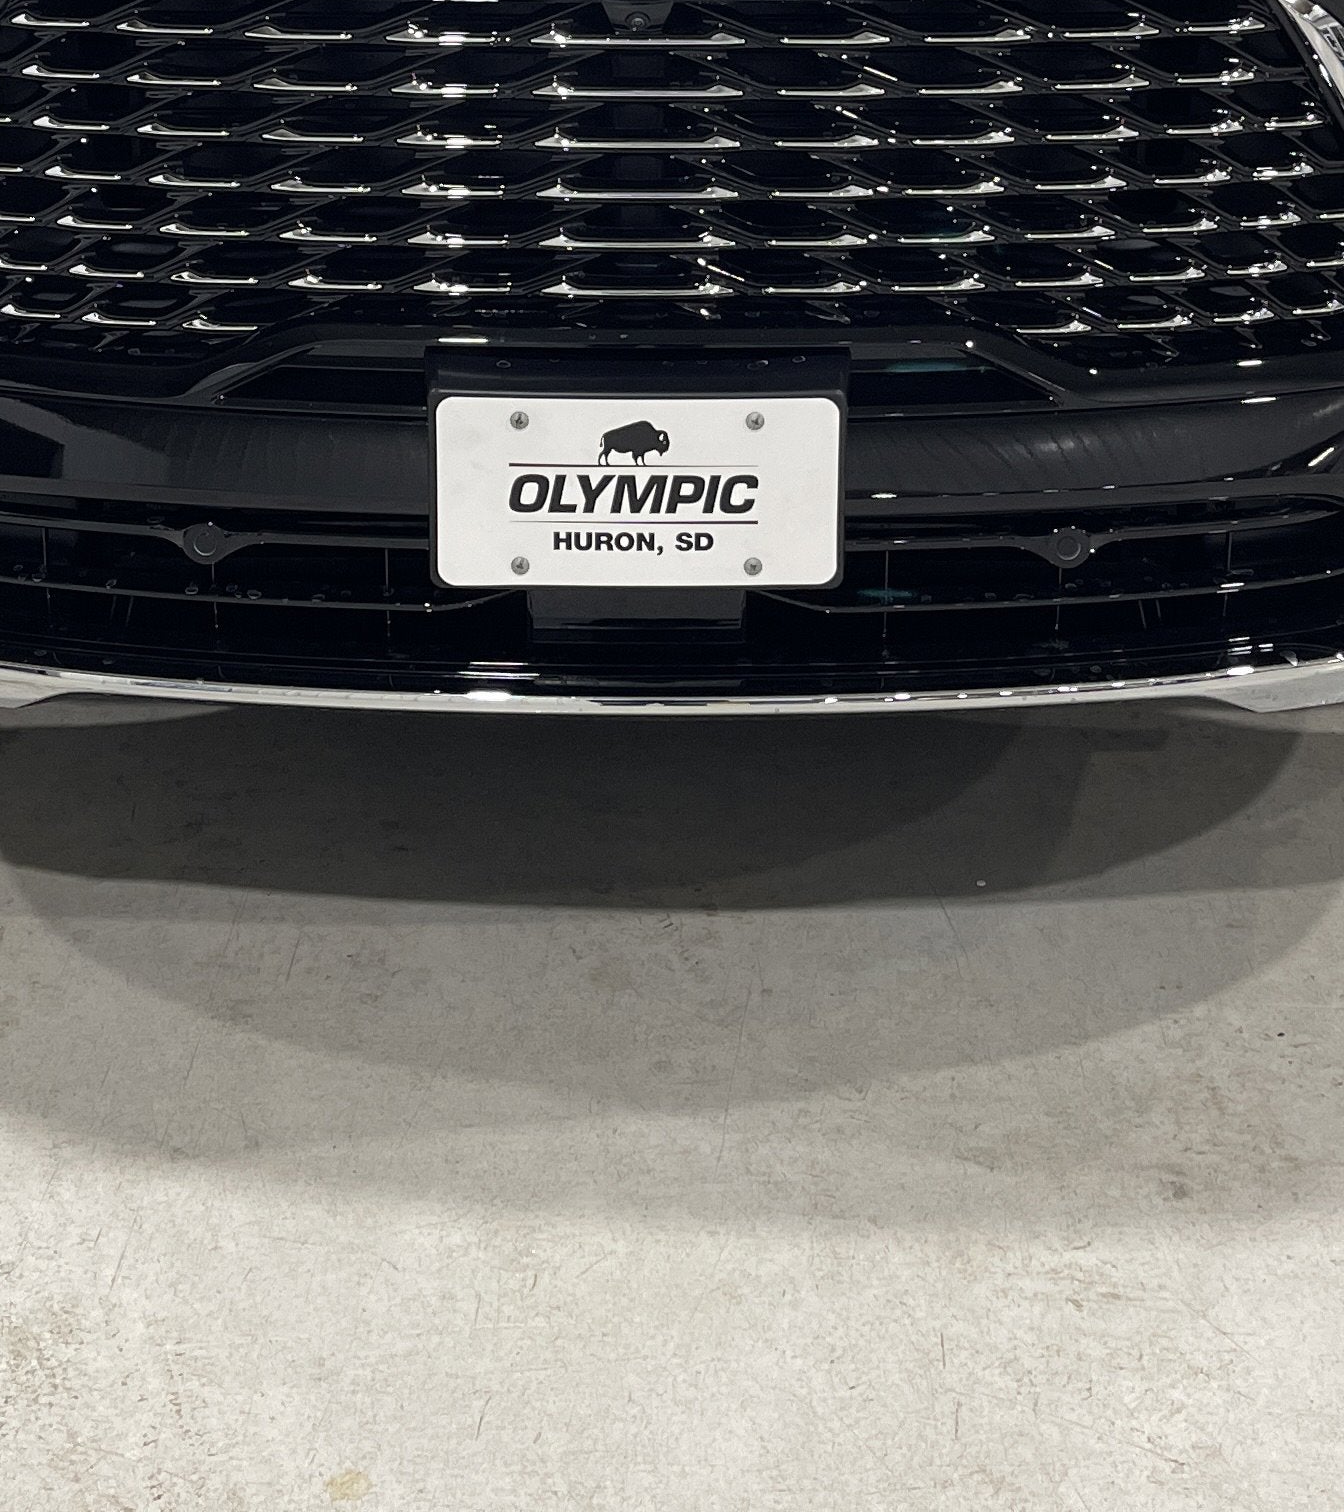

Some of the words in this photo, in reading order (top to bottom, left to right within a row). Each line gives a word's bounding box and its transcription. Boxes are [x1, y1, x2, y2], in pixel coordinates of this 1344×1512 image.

[508, 473, 760, 515] OLYMPIC
[553, 531, 665, 555] HURON,
[674, 531, 715, 552] SD
